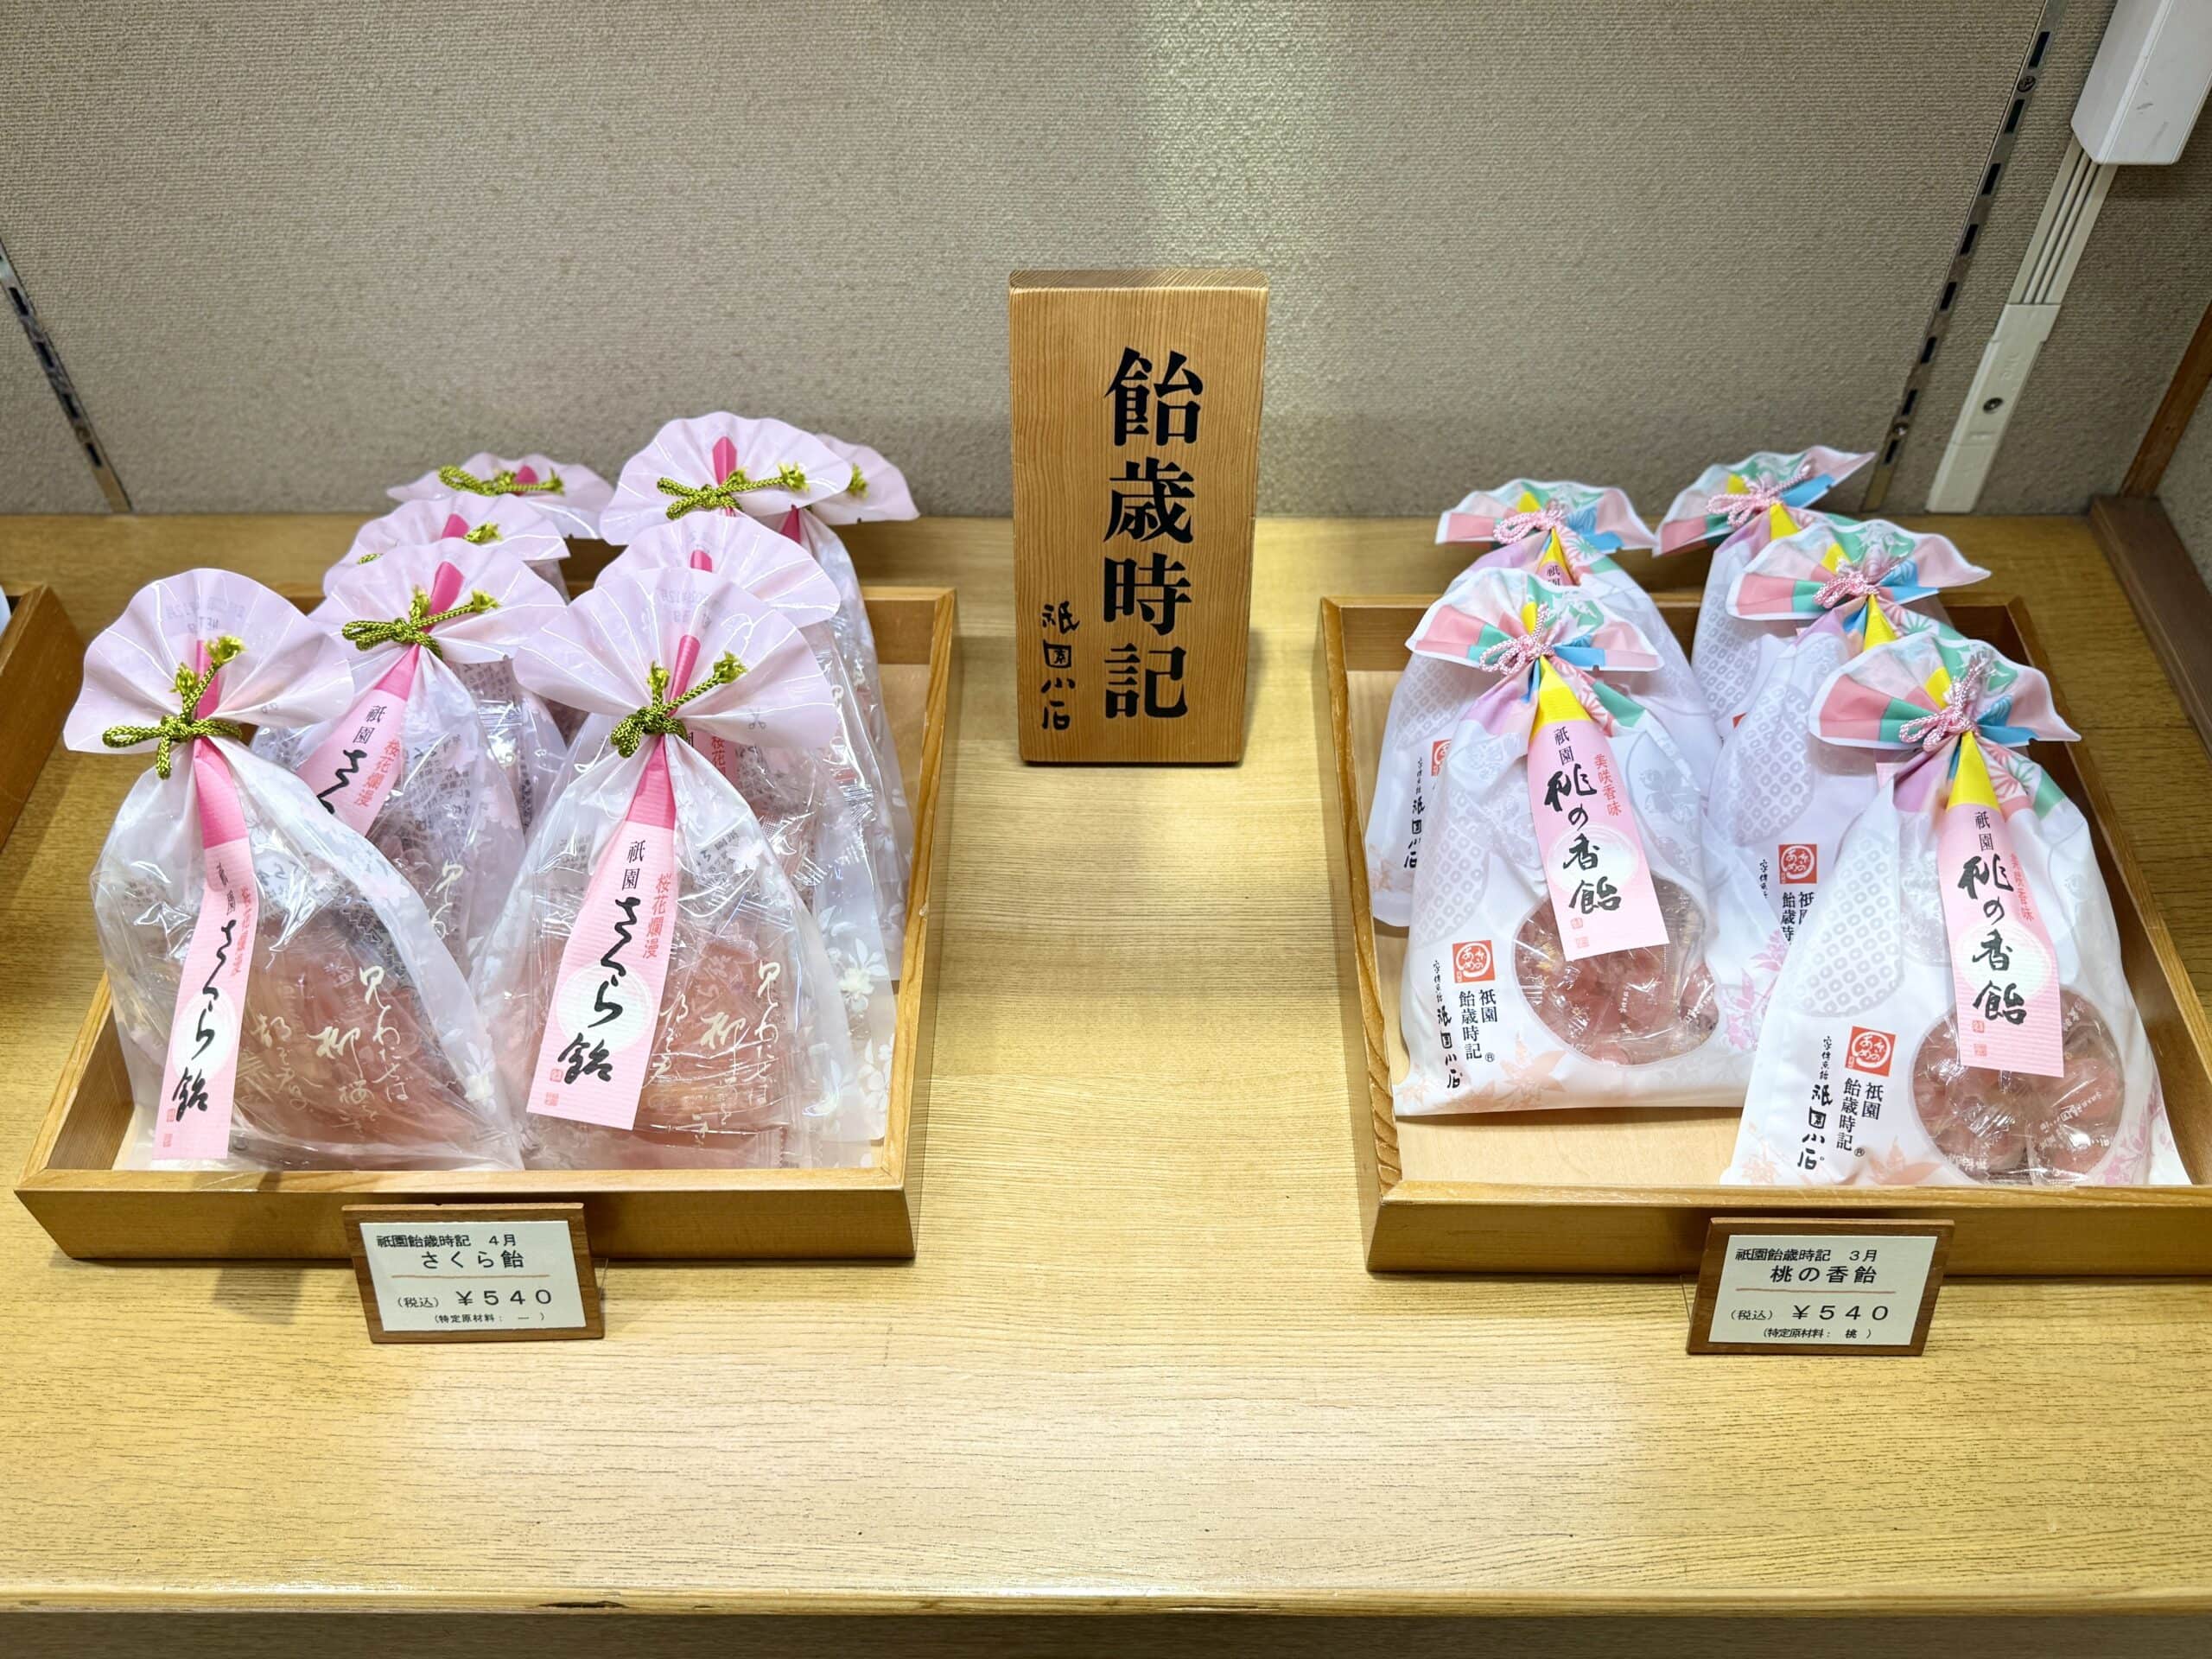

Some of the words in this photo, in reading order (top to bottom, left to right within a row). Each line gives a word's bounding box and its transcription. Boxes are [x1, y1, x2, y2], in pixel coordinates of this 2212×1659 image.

[1103, 347, 1204, 719] 飴歳時記
[1554, 726, 1574, 765] 祇園
[1594, 753, 1622, 816] 美咲香味
[1544, 763, 1622, 914] 桃の香飴
[1975, 811, 1994, 851] 祇園
[622, 840, 645, 890] 祇園
[1957, 853, 2027, 1025] 桃の香飴
[557, 897, 641, 1084] さくら飴
[1479, 989, 1498, 1023] 祇園
[1836, 1078, 1861, 1151] 飴歳時記
[1861, 1083, 1885, 1120] 祇園
[377, 1235, 471, 1247] 祇園飴歳時記
[488, 1234, 517, 1247] 4月
[421, 1250, 524, 1268] さくら飴
[1735, 1249, 1831, 1262] 祇園飴歳時記
[1849, 1249, 1878, 1262] 3月
[1770, 1266, 1877, 1283] 桃の香飴
[397, 1297, 439, 1308] (税込)
[456, 1289, 552, 1306] ¥540
[1731, 1310, 1773, 1320] (税込)
[1792, 1306, 1889, 1320] ¥540
